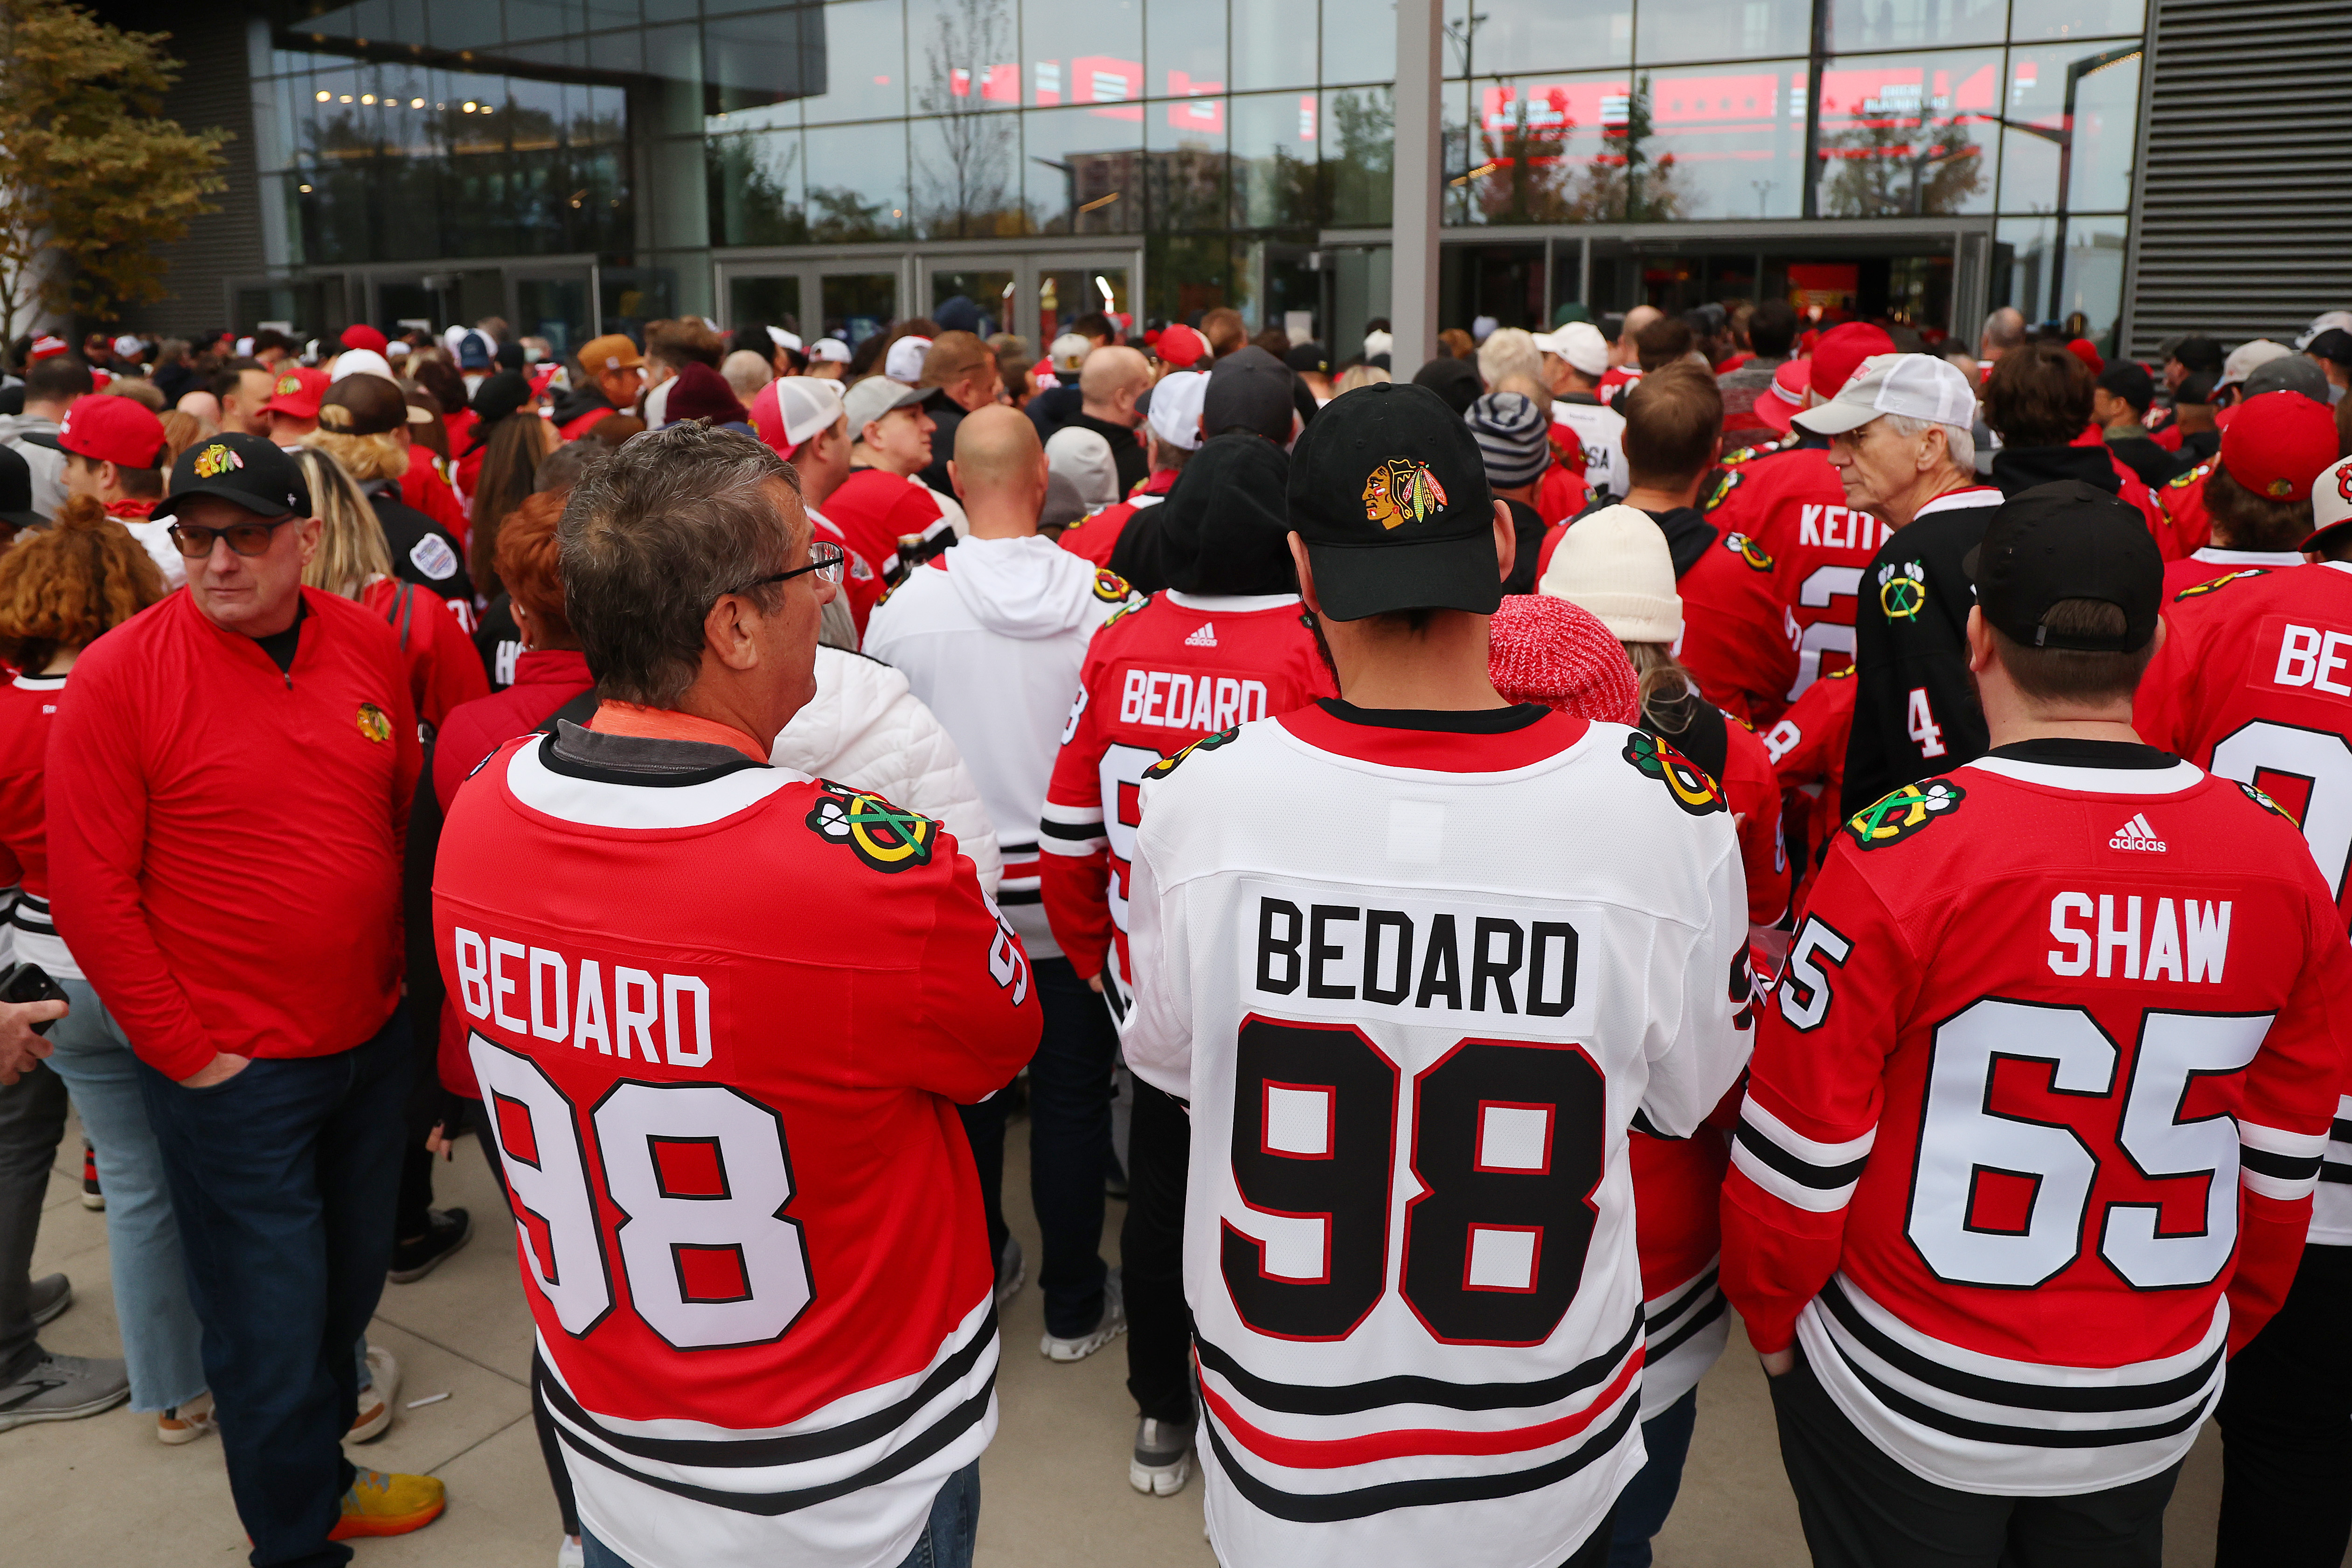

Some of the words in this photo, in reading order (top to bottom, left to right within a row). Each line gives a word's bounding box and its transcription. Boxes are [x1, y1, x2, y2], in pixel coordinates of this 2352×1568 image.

[1799, 504, 1895, 550] KEIT
[1185, 637, 1218, 647] adidas
[1120, 669, 1267, 732] BEDARD
[1908, 687, 1949, 759] 4
[2109, 836, 2167, 852] adidas
[1256, 896, 1578, 1017] BEDARD
[1777, 911, 1855, 1034] 5
[2048, 892, 2232, 983] SHAW
[455, 927, 713, 1068] BEDARD
[468, 1026, 815, 1353] 98
[1221, 1011, 1606, 1348] 98
[1903, 995, 2281, 1292] 65
